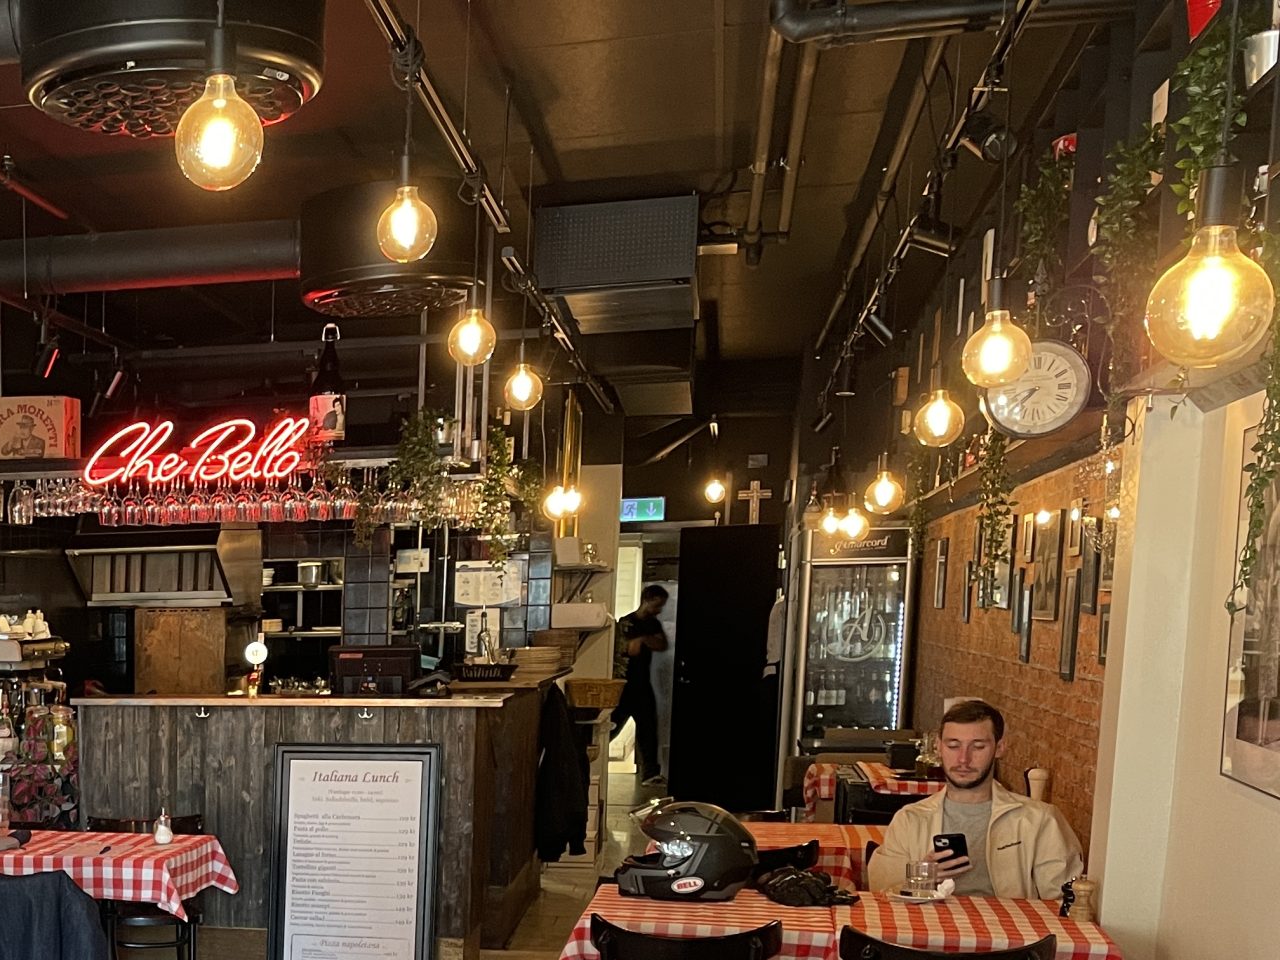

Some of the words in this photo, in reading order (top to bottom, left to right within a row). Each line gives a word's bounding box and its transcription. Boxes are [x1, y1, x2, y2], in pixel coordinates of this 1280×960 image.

[17, 404, 58, 448] MORETTI
[83, 420, 188, 485] Che
[189, 417, 310, 482] Bello
[312, 770, 358, 783] Italiana
[362, 771, 400, 783] Lunch
[677, 881, 698, 889] BELL
